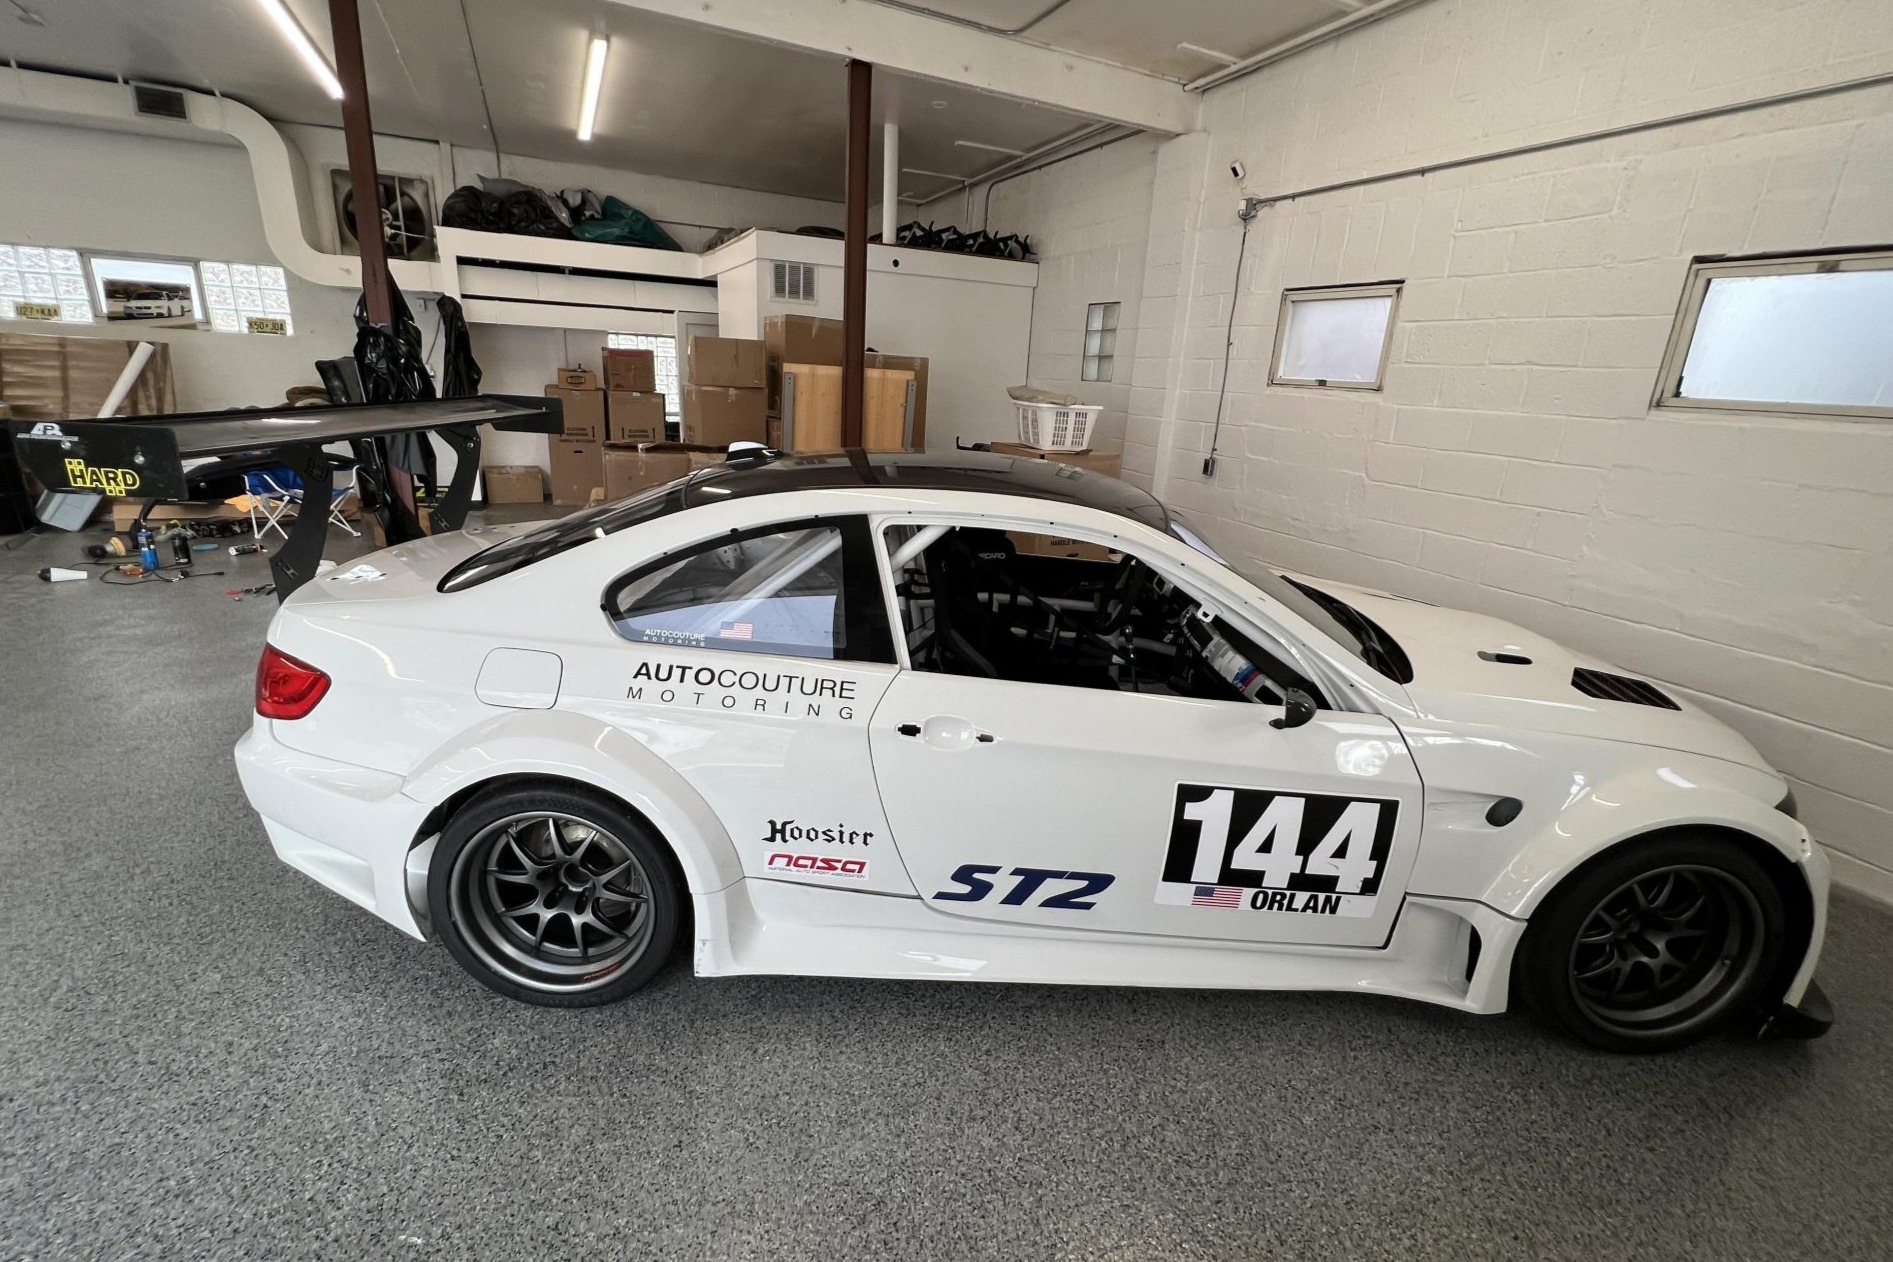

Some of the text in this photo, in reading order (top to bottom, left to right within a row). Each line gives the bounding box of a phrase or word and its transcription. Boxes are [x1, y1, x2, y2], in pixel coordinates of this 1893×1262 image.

[65, 462, 140, 491] HARD
[645, 628, 706, 641] AUTOCOUTURE
[632, 661, 857, 700] AUTOCOUTURE
[626, 686, 853, 720] MOTORING
[762, 819, 875, 848] Hoosier
[1183, 788, 1381, 894] 144
[932, 863, 1116, 910] ST2
[1250, 889, 1342, 915] ORLAN
